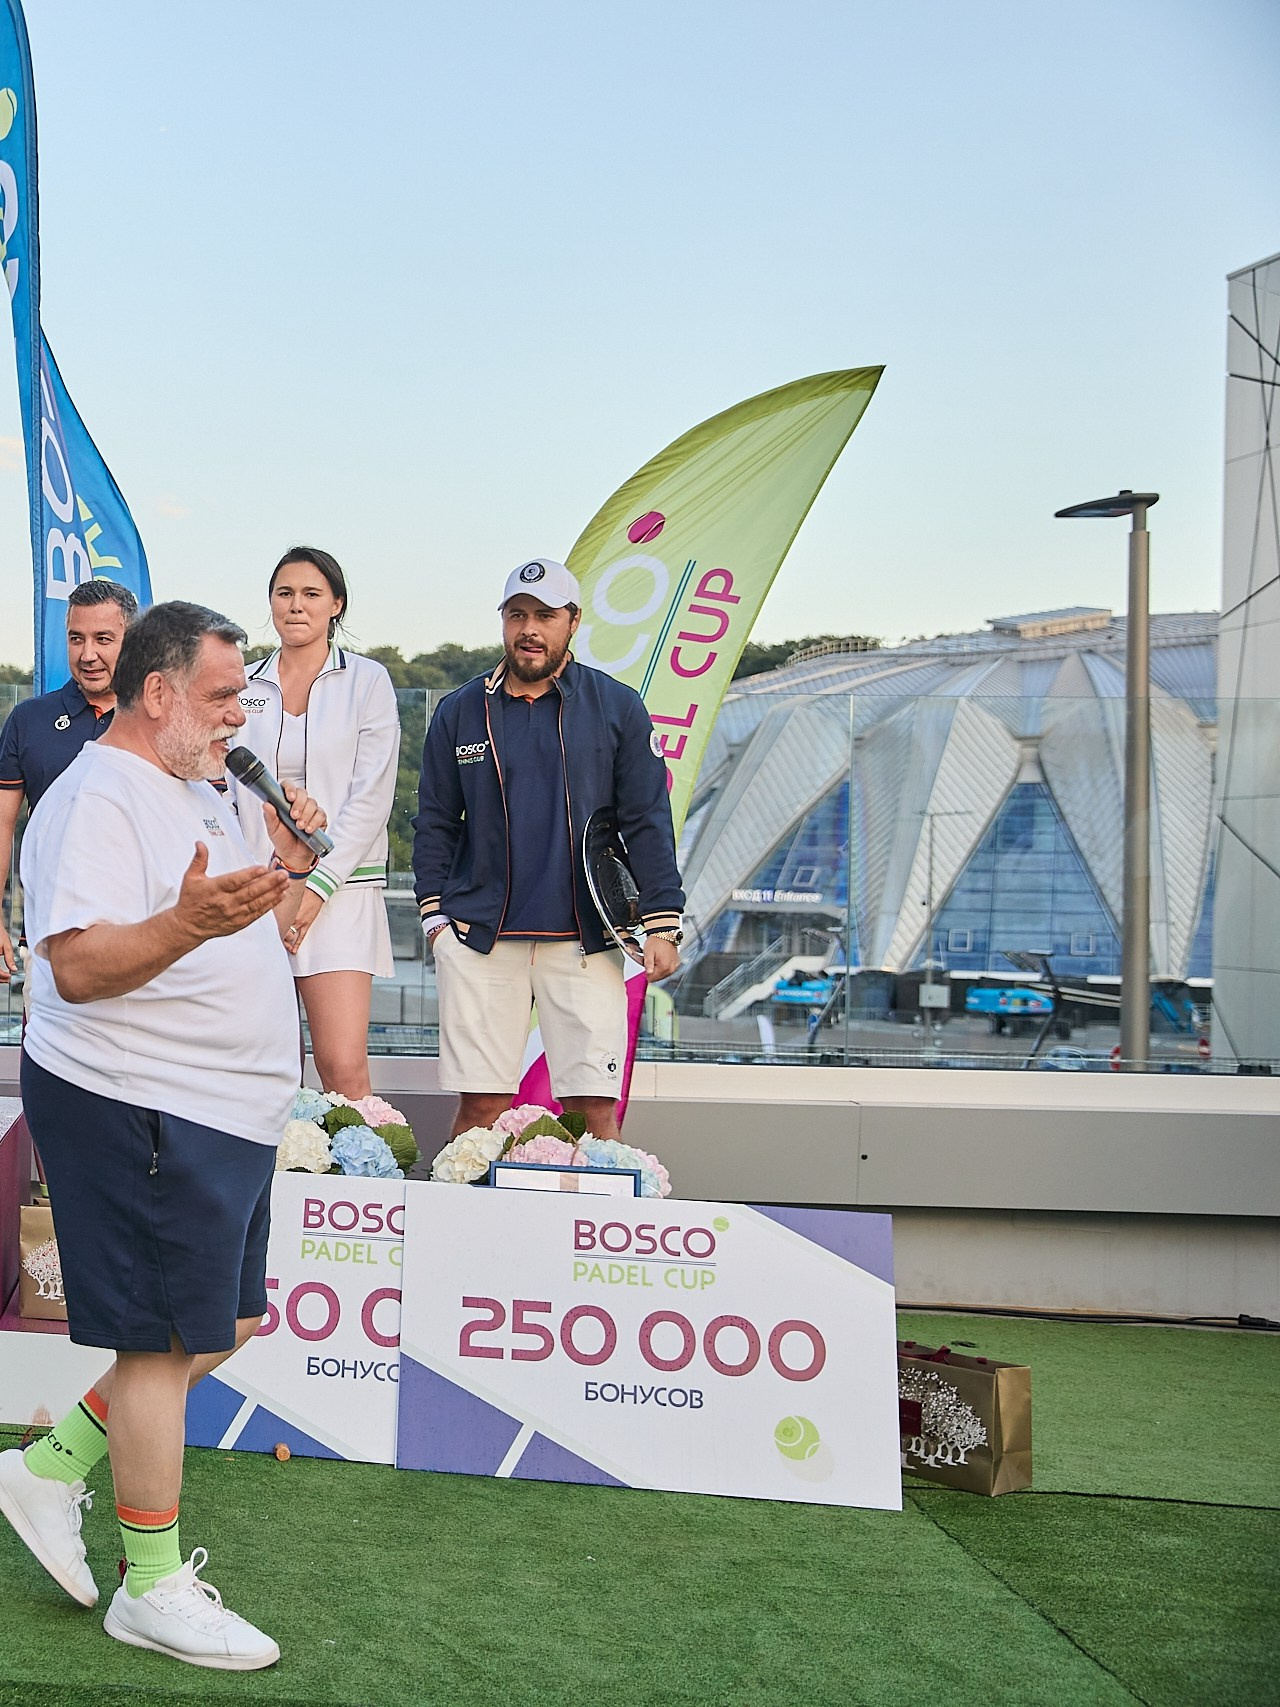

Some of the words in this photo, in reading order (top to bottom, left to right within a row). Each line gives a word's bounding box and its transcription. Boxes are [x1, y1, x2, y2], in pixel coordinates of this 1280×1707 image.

[670, 567, 741, 678] CUP
[238, 697, 266, 707] OSCO
[303, 1198, 405, 1236] BOSC
[300, 1239, 378, 1265] PADEL
[574, 1219, 716, 1259] BOSCO
[573, 1261, 653, 1287] PADEL
[664, 1268, 716, 1291] CUP
[252, 1277, 341, 1342] 50
[459, 1296, 617, 1366] 250
[638, 1310, 827, 1382] 000
[584, 1381, 704, 1409] БОНУСОВ
